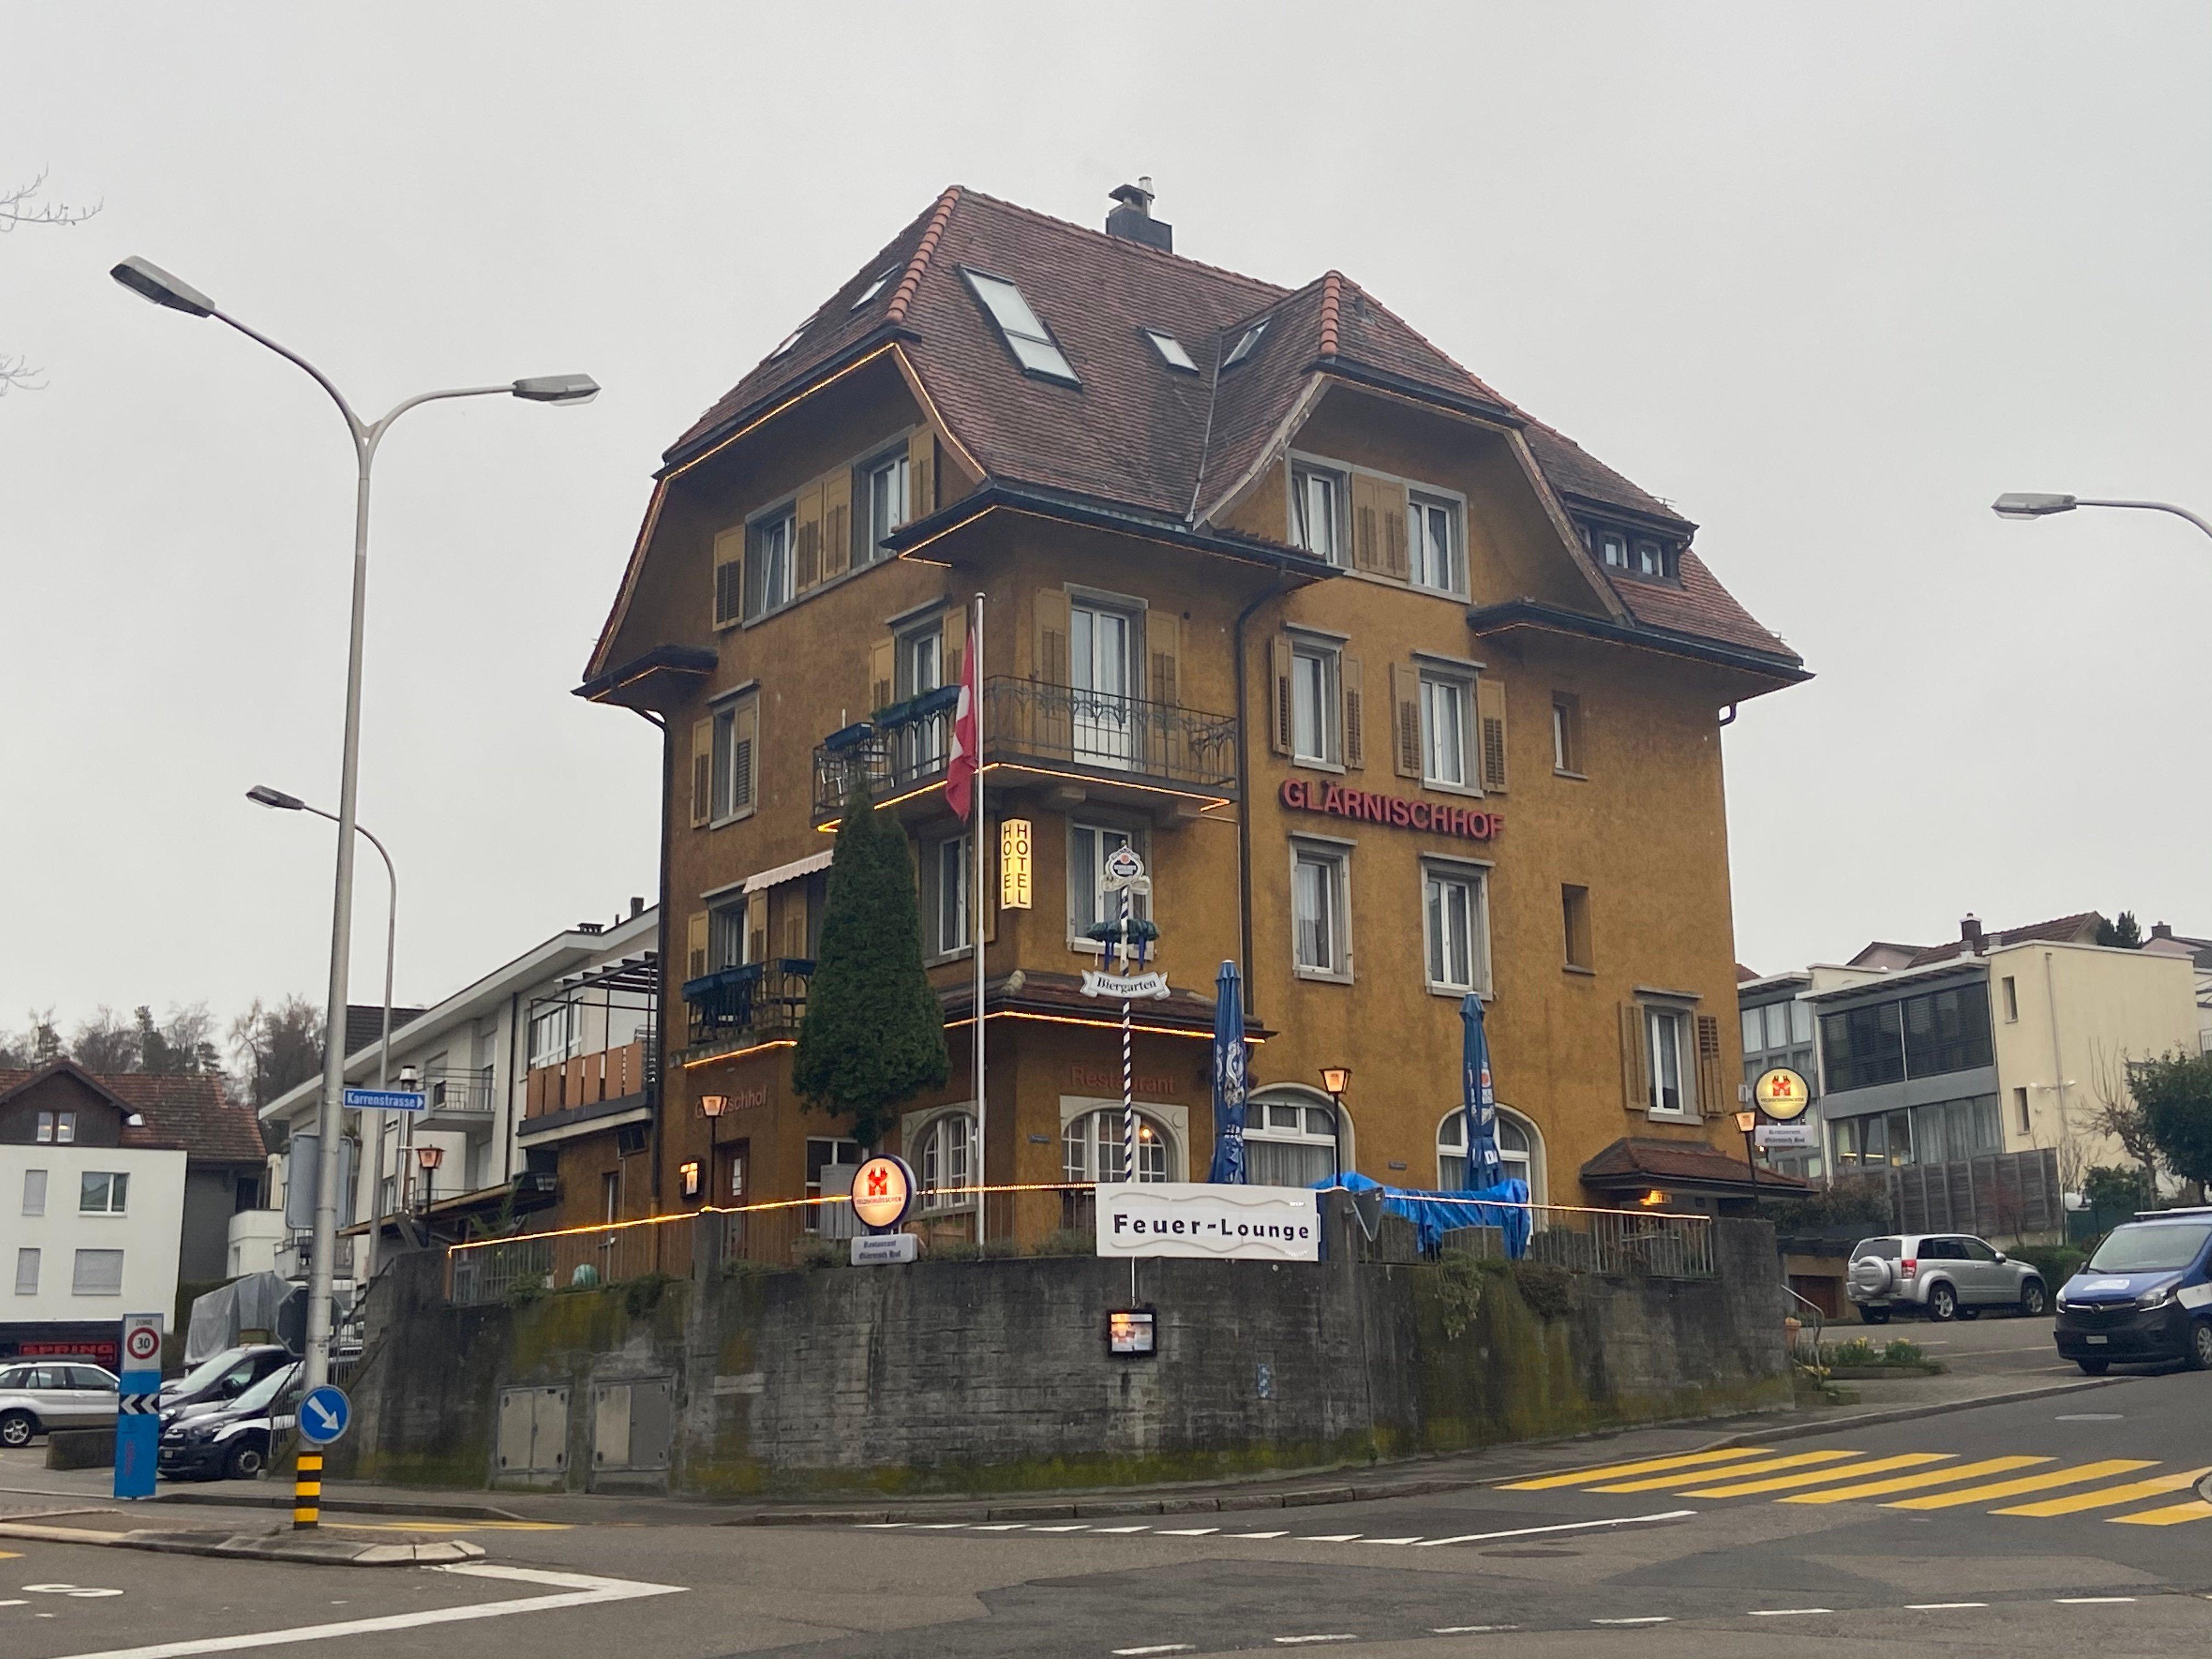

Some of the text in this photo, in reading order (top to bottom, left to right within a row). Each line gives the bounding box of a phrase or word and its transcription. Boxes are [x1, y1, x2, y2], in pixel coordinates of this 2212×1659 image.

[1280, 778, 1505, 840] GLÄRNISCHHOF
[1003, 823, 1012, 905] HOTEL
[1016, 823, 1028, 905] HOTEL
[1097, 976, 1157, 994] Biergarten
[347, 1091, 415, 1107] Karrenstrasse
[695, 1086, 768, 1119] Gschhof
[1113, 1214, 1310, 1241] Feuer-Lounge
[137, 1338, 151, 1350] 30
